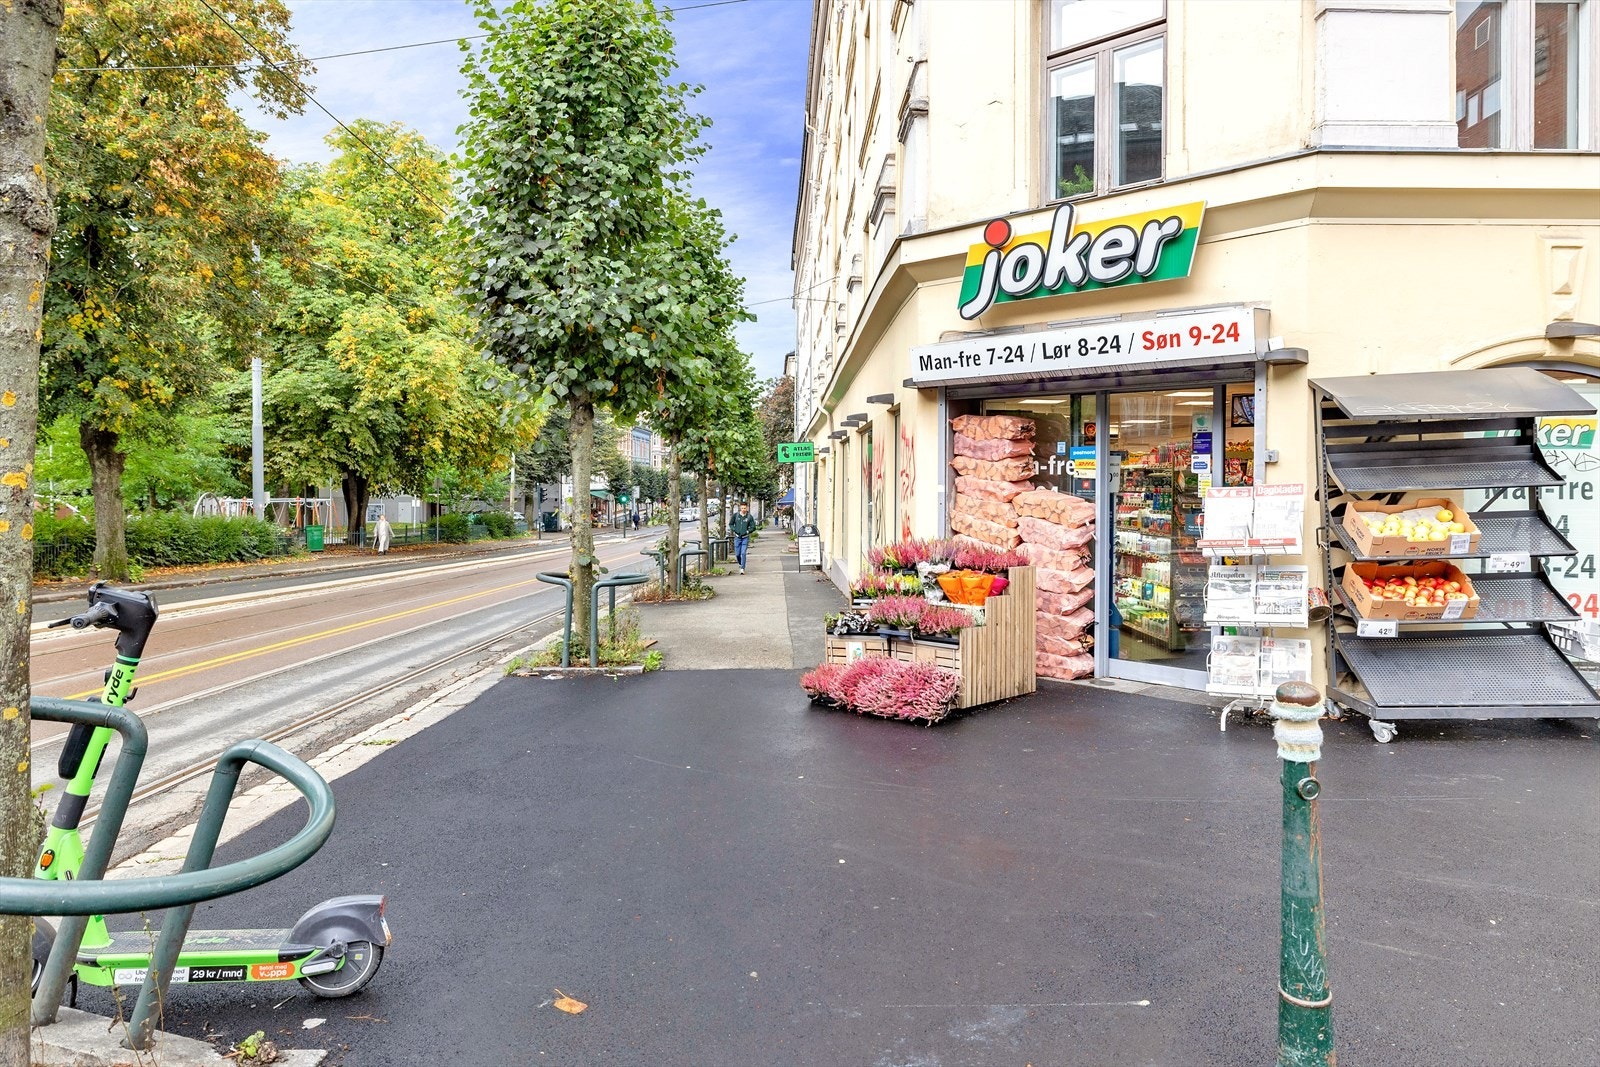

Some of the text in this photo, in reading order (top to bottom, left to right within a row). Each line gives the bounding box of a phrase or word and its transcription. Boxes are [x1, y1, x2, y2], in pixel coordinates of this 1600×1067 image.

[959, 202, 1185, 321] joker
[919, 322, 1240, 372] Man-fre 7-24 / Lør 8-24 / Søn 9-24
[1208, 489, 1251, 498] VG
[1257, 485, 1302, 495] Dagbladet
[107, 669, 124, 704] ryde
[192, 969, 243, 979] 29 kr / mnd
